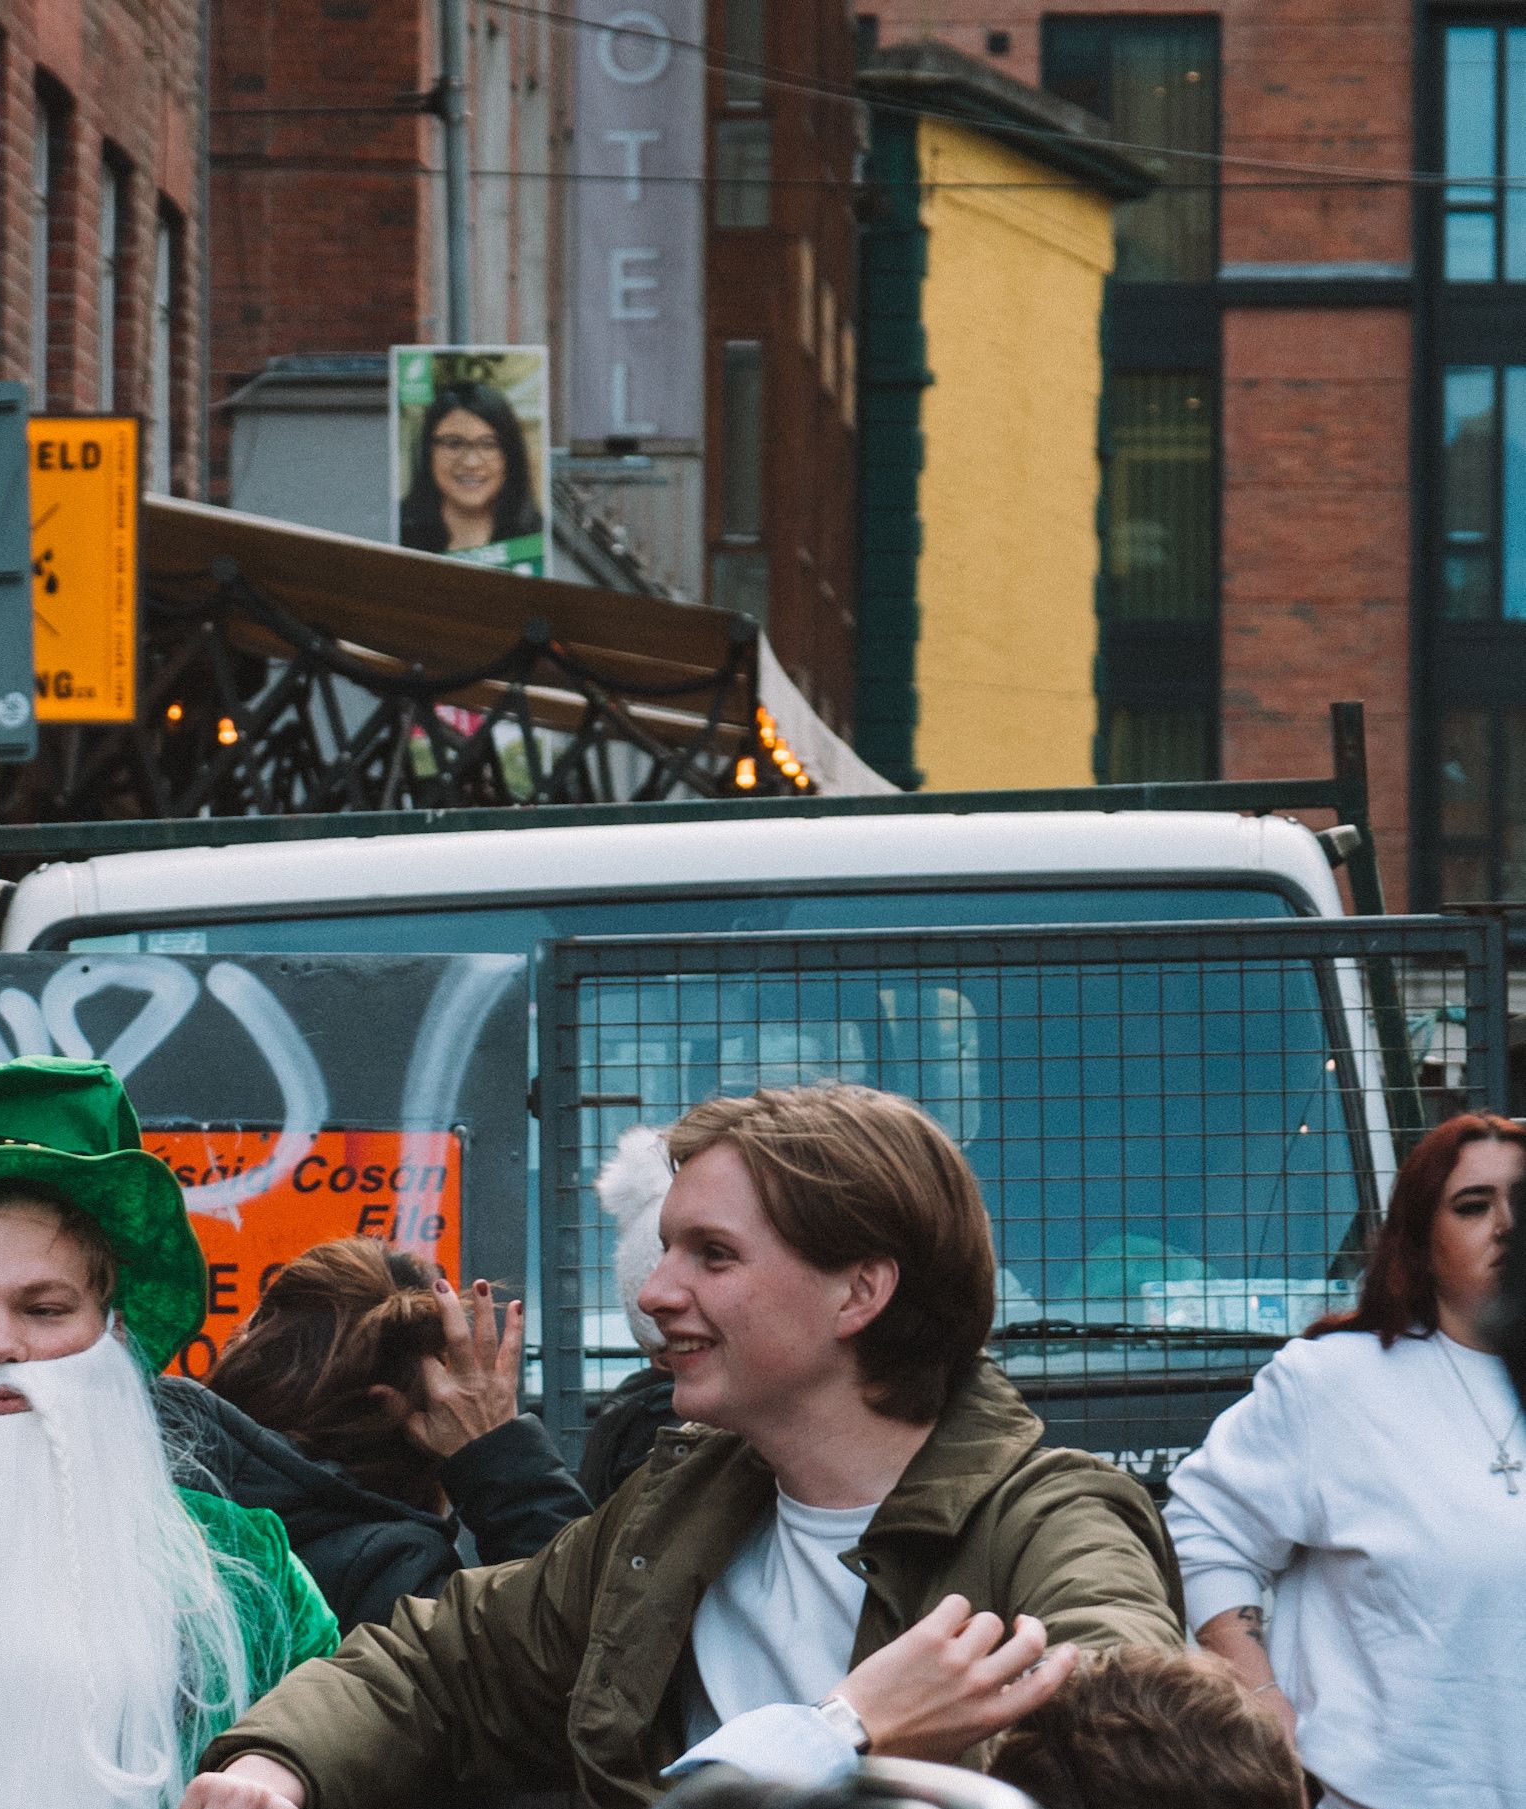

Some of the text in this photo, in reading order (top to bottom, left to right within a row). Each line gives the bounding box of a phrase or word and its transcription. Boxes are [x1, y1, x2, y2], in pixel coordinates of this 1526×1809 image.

[36, 440, 102, 471] ELD
[34, 669, 74, 700] NG
[292, 1154, 447, 1194] Cosán
[356, 1203, 447, 1241] Eile
